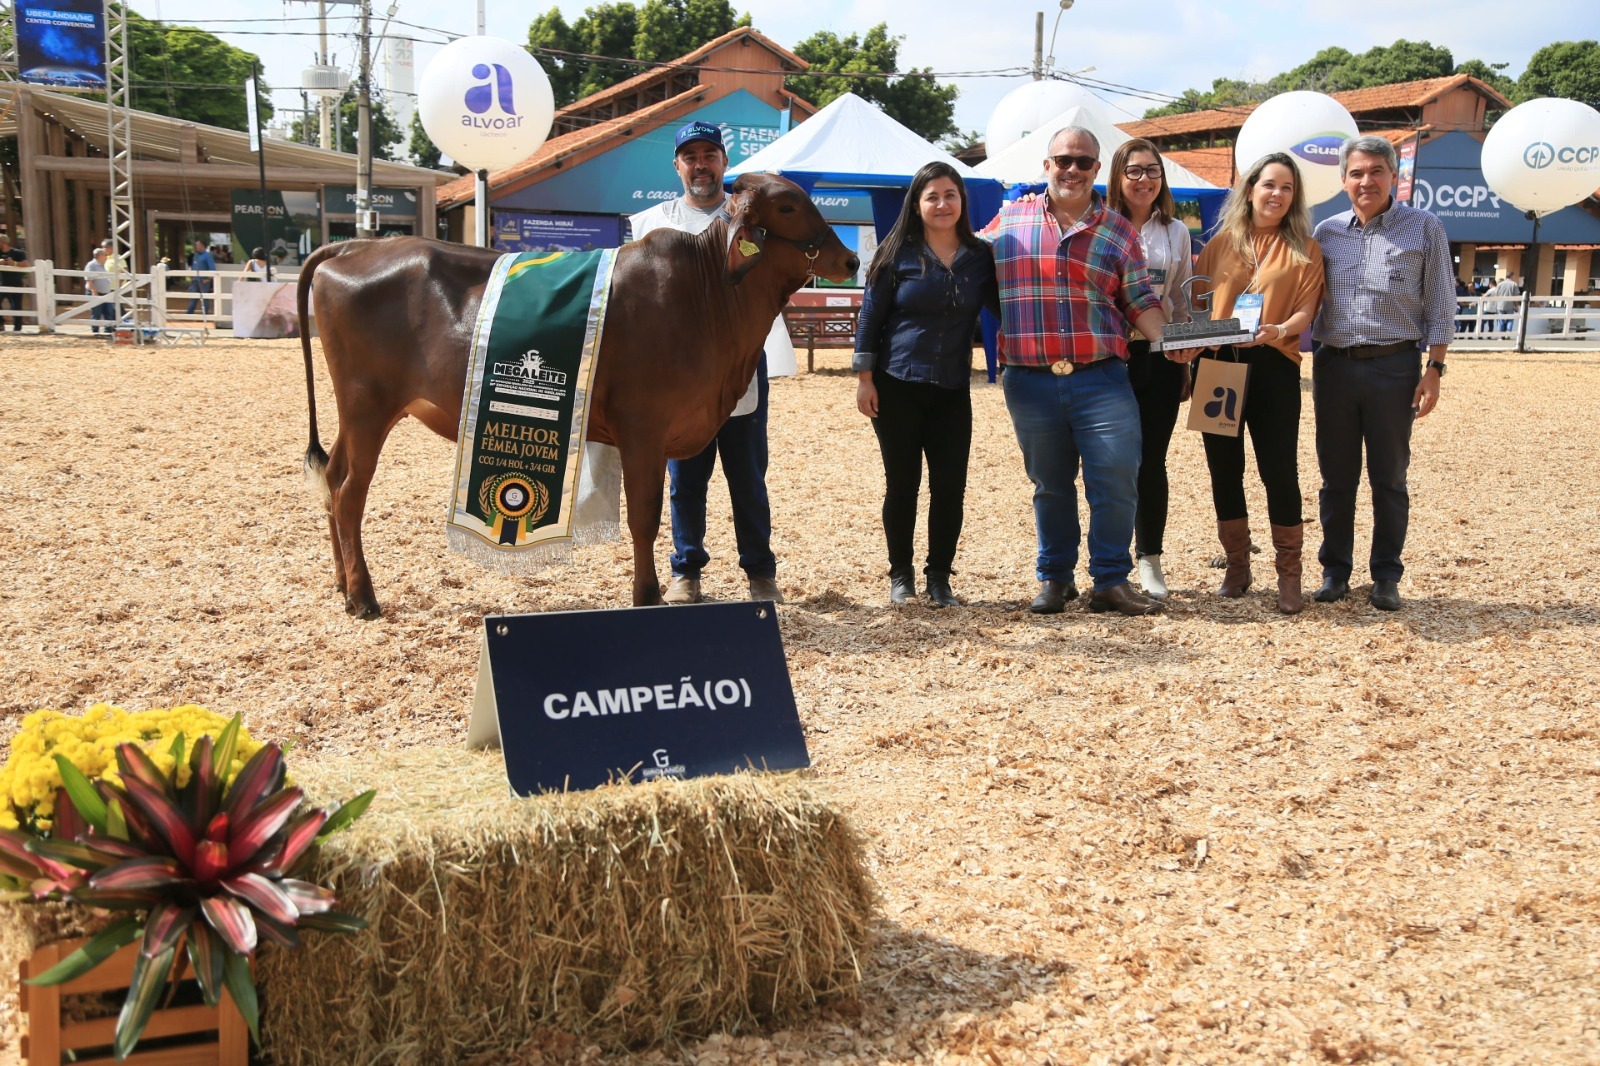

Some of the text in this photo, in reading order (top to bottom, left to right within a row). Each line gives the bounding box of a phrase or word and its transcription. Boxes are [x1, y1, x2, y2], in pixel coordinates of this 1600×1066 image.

[26, 9, 93, 22] UBERLÂNDIA/MG
[52, 20, 95, 28] CONVENTION
[346, 193, 394, 203] PESON
[646, 190, 678, 199] casa
[234, 204, 284, 215] PEARON
[1437, 209, 1453, 217] UNIÃO
[482, 420, 560, 446] MELHOR
[480, 436, 559, 460] FÊMEA JOVEM
[478, 455, 494, 465] CCG
[495, 458, 507, 467] 1/4
[508, 459, 523, 469] HOL
[529, 462, 541, 471] 3/4
[542, 464, 556, 473] GIR
[543, 675, 752, 720] CAMPEÃ(O)
